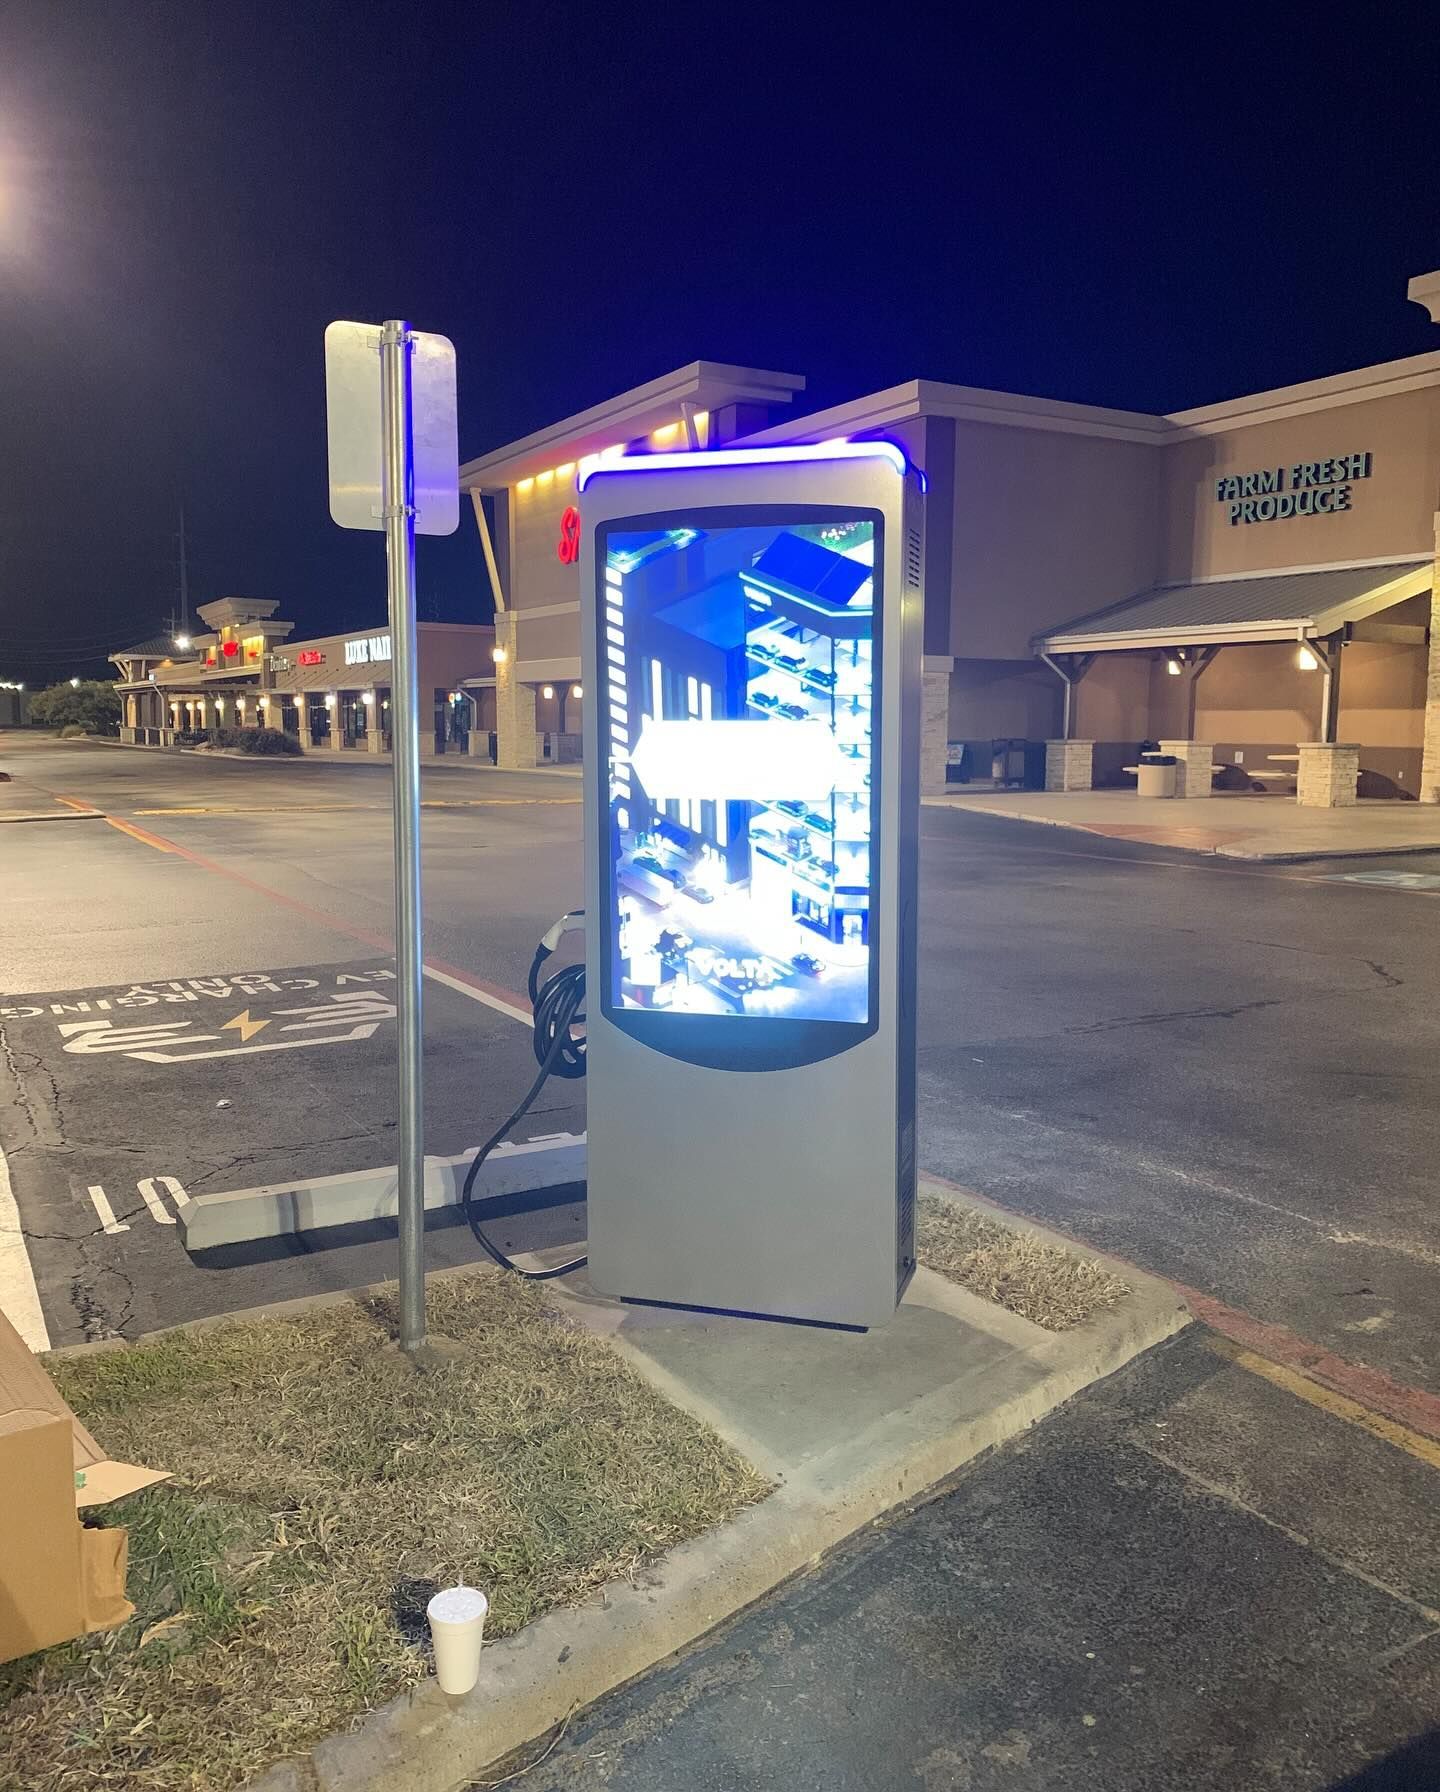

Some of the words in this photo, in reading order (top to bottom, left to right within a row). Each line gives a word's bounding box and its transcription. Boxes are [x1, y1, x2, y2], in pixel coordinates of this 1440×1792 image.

[1215, 468, 1283, 501] FARM
[1288, 452, 1371, 489] FRESH
[1227, 485, 1351, 525] PRODUCE
[121, 974, 272, 998] ONLY
[336, 969, 397, 985] EV
[0, 978, 320, 1019] CHARGING
